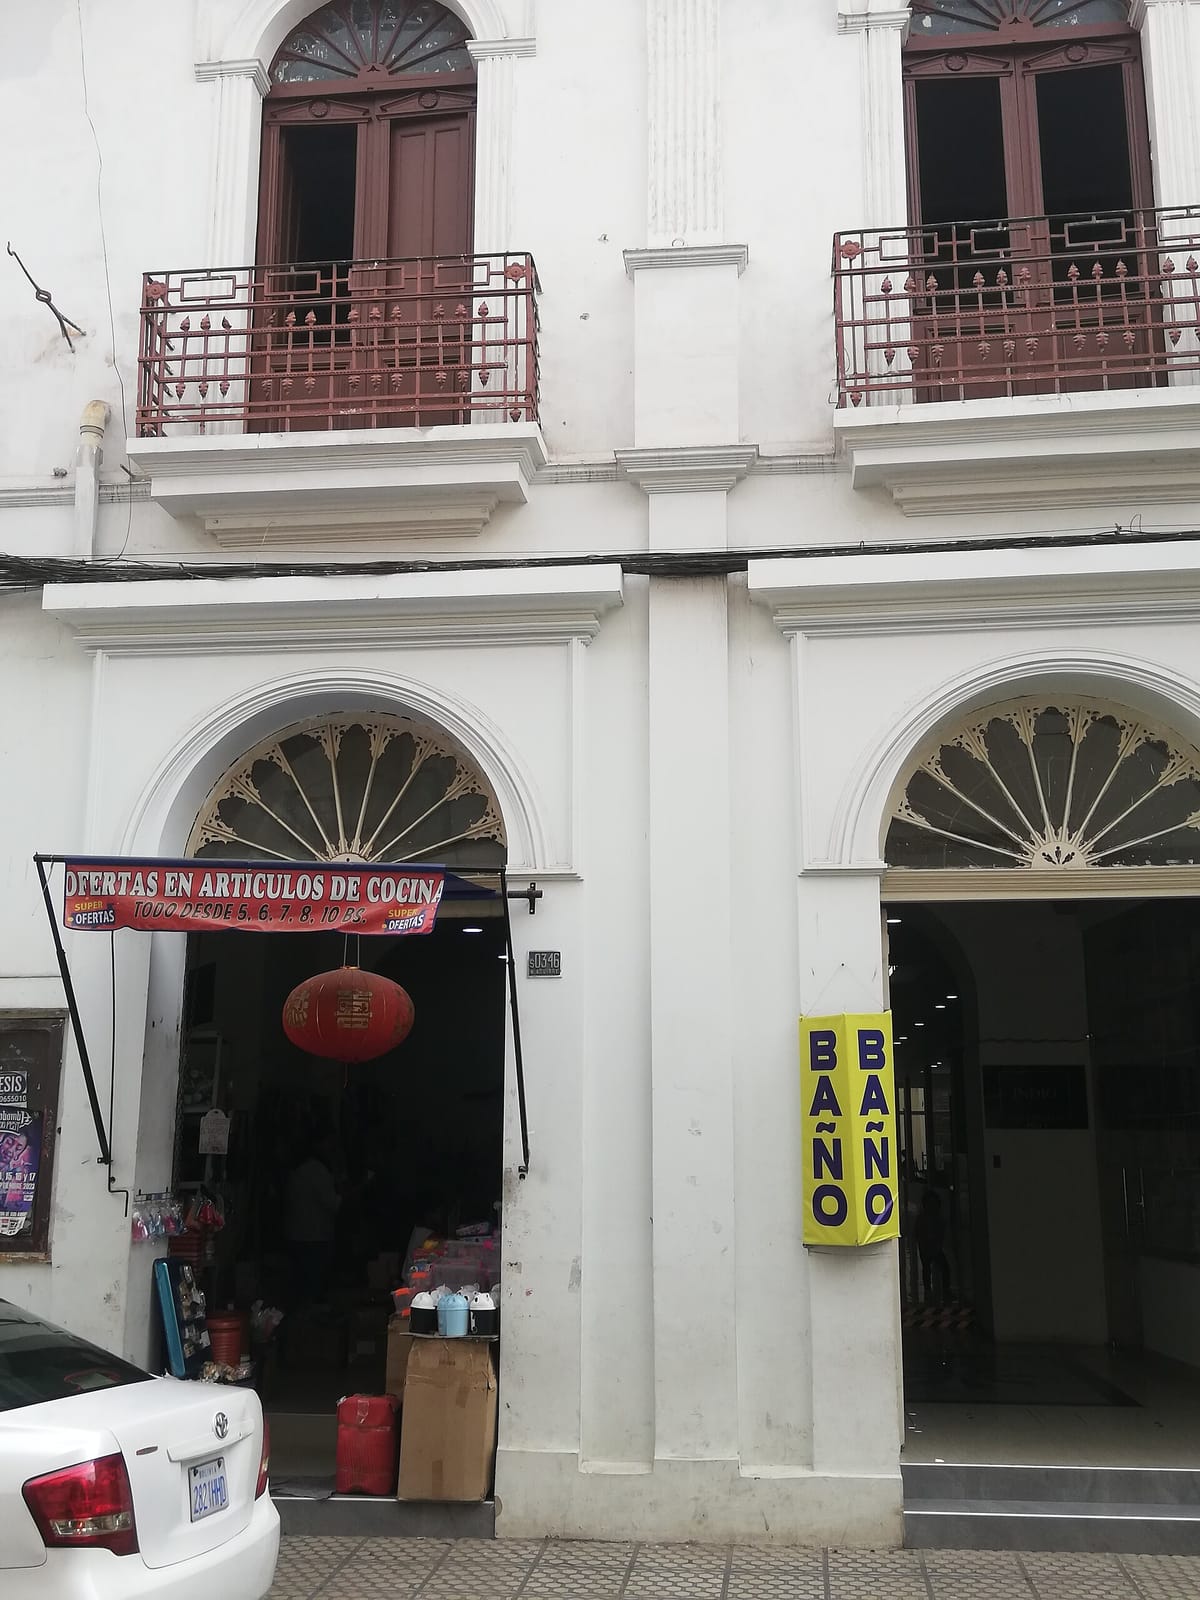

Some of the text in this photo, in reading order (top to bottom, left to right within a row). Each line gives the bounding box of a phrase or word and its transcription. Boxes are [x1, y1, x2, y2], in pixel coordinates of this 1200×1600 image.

[66, 868, 445, 904] OFERTAS EN ARTÍCULOS DE COCINA
[74, 901, 103, 911] SUPER
[133, 901, 178, 918] TODO
[179, 902, 234, 920] DESDE
[320, 906, 340, 924] 10
[388, 908, 418, 918] SUPER
[75, 909, 115, 925] OFERTAS
[388, 914, 425, 930] OFERTAS
[809, 1030, 848, 1227] BAÑO
[857, 1029, 895, 1227] BAÑO
